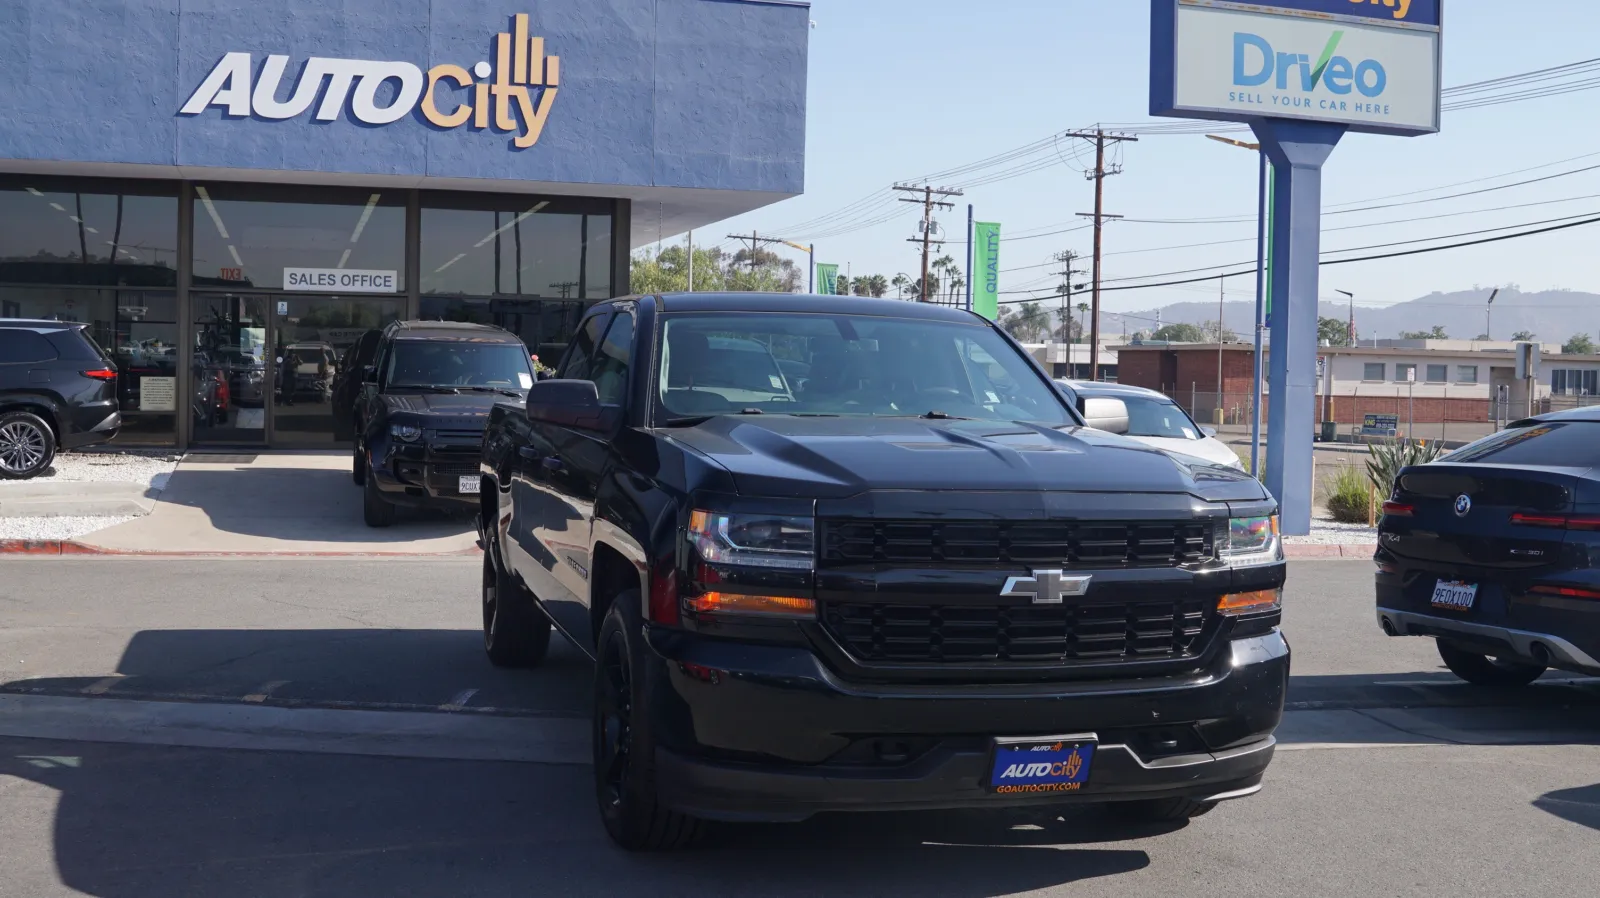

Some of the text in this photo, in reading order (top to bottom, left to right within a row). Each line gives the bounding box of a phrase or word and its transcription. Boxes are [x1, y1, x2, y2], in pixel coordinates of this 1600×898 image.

[1229, 91, 1390, 115] SELL YOUR CAR HERE
[289, 272, 392, 288] SALES OFFICE
[1388, 532, 1401, 543] X4
[996, 782, 1081, 793] GOAUTOCITY.COM
